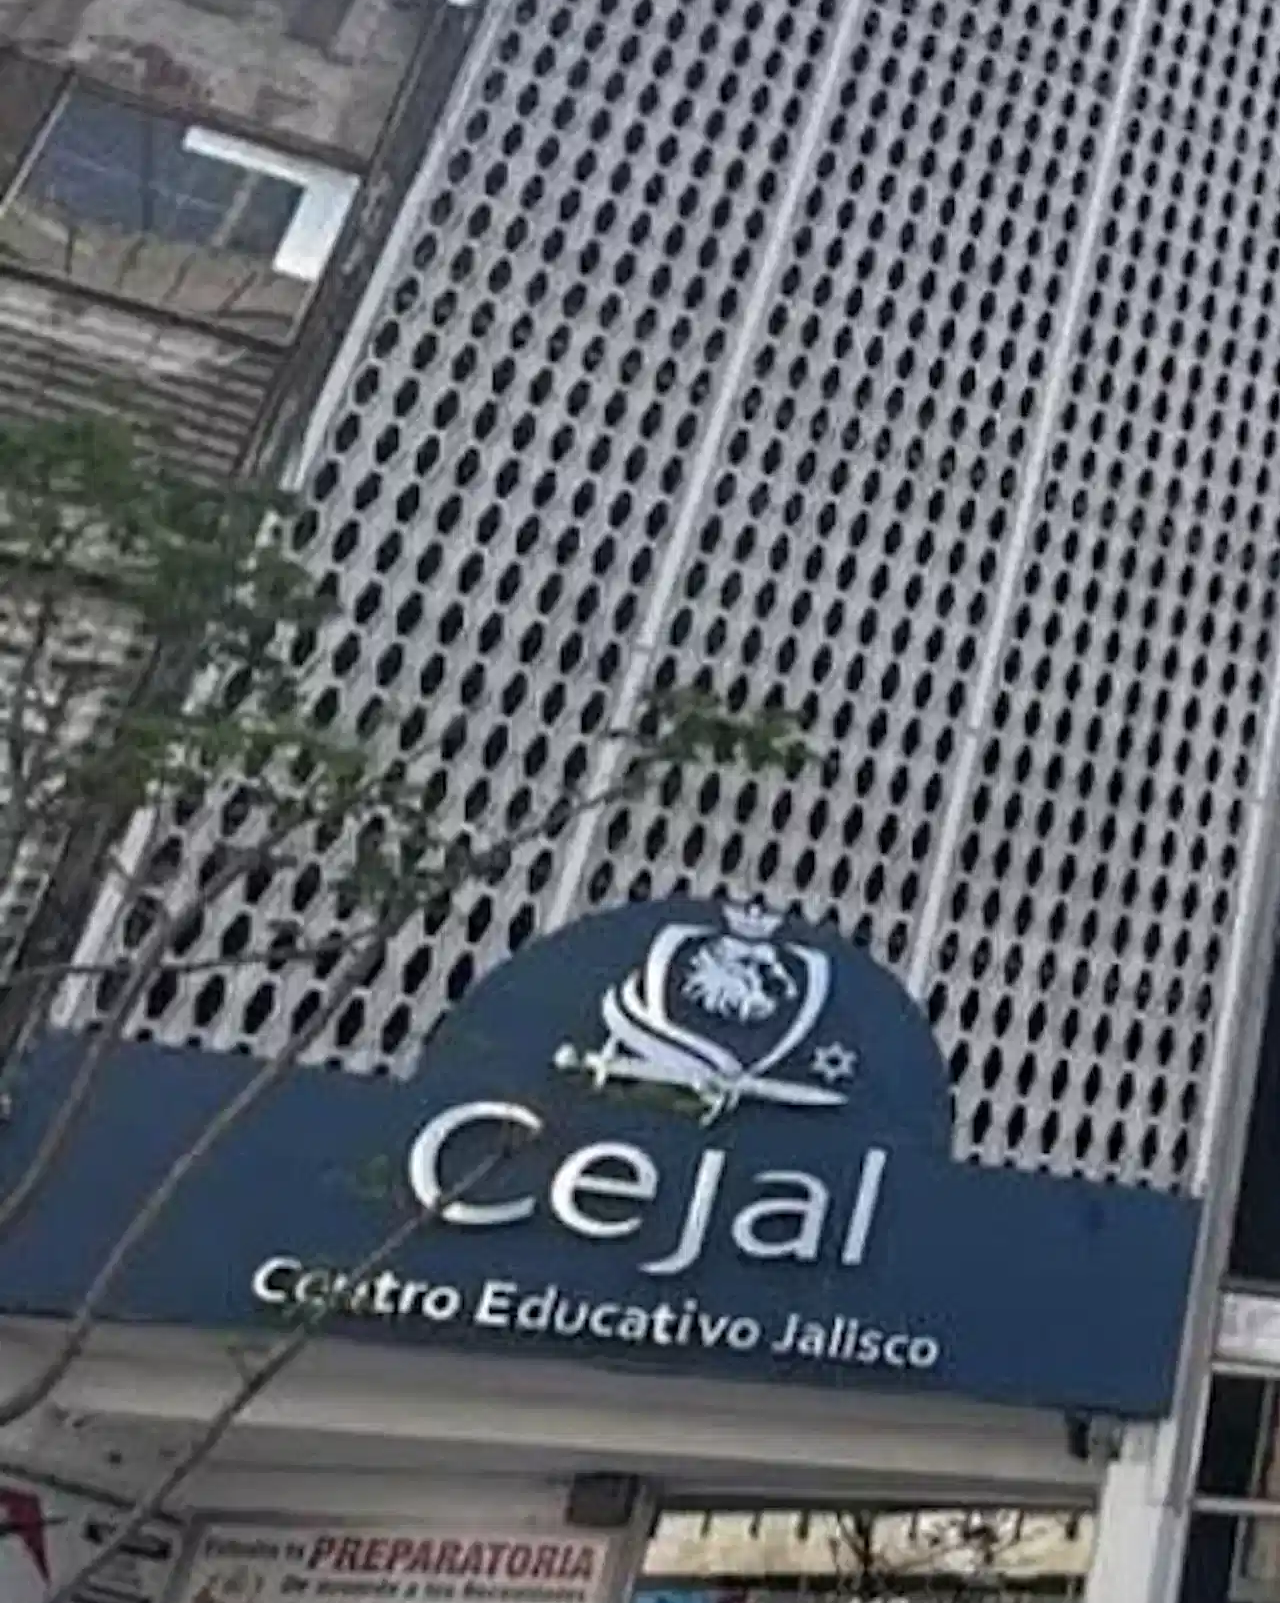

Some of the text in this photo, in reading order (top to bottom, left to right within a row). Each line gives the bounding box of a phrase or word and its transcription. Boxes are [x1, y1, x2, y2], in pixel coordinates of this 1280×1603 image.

[474, 1278, 761, 1349] Educativo
[770, 1312, 940, 1368] Jalisco
[306, 1534, 596, 1581] PREPARATORIA
